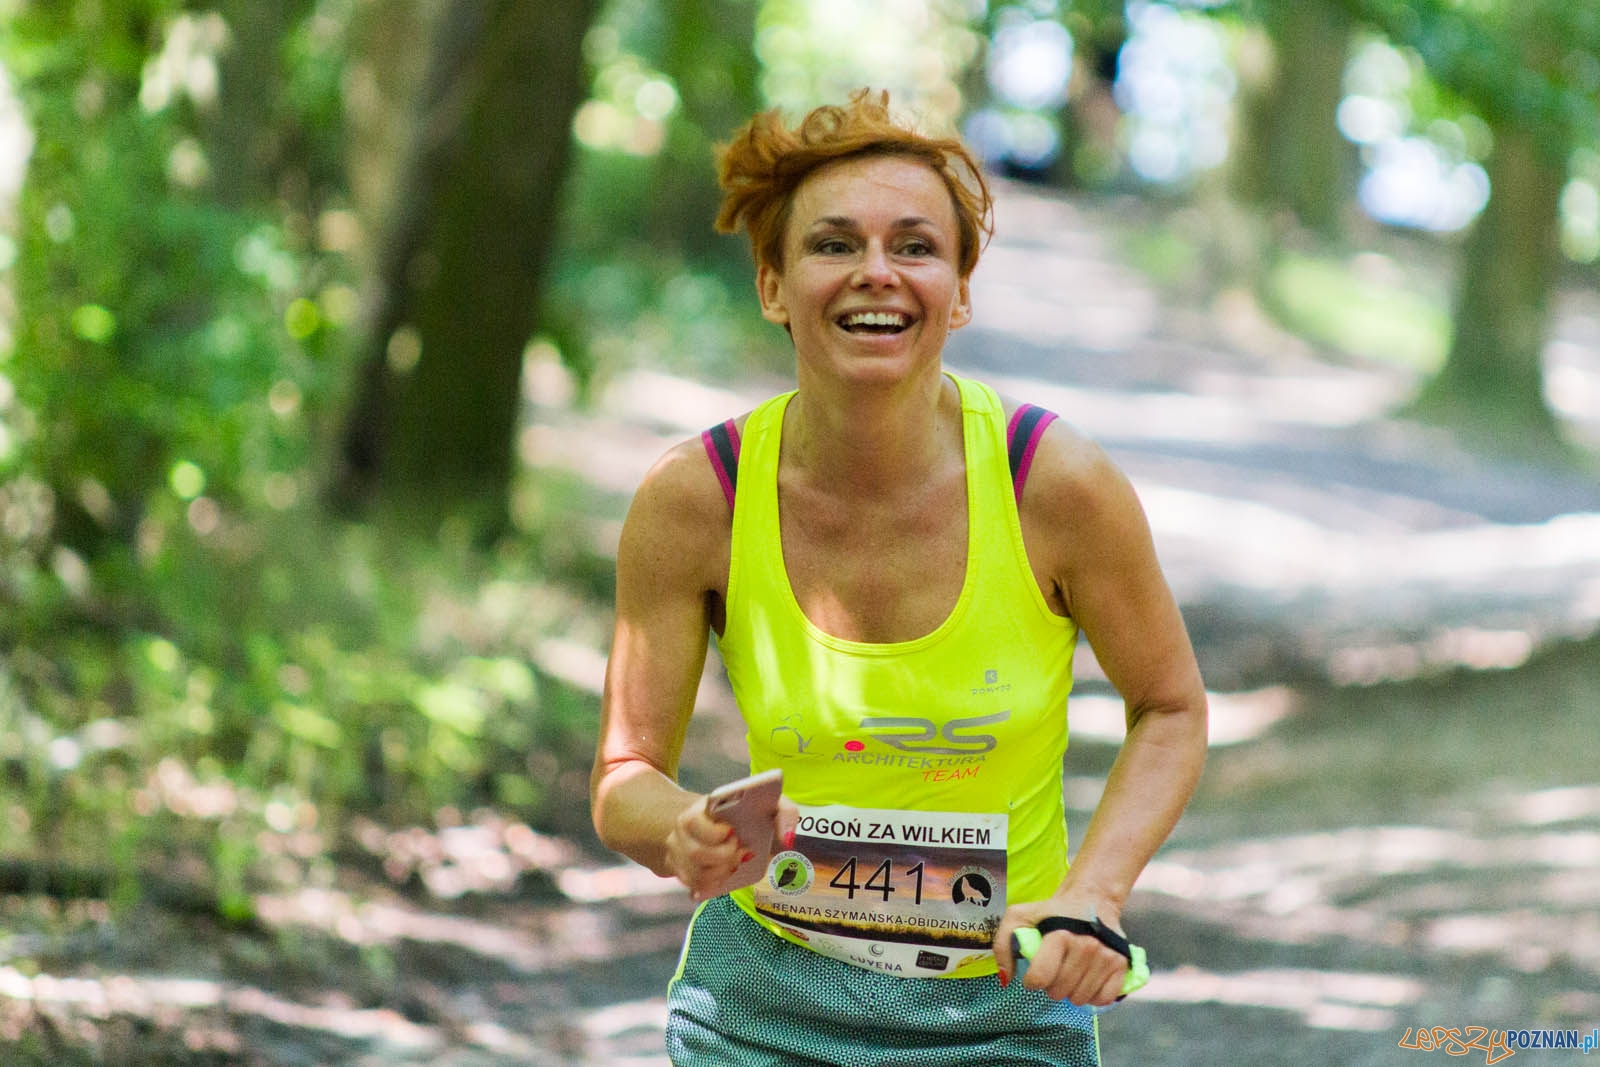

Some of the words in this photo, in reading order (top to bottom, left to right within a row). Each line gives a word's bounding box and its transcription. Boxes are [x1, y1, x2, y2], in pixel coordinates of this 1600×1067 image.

[832, 752, 986, 769] ARCHITEKTURA
[922, 766, 980, 783] TEAM
[867, 824, 896, 840] ZA
[902, 825, 991, 845] WILKIEM
[829, 856, 925, 905] 441
[772, 902, 822, 917] RENATA
